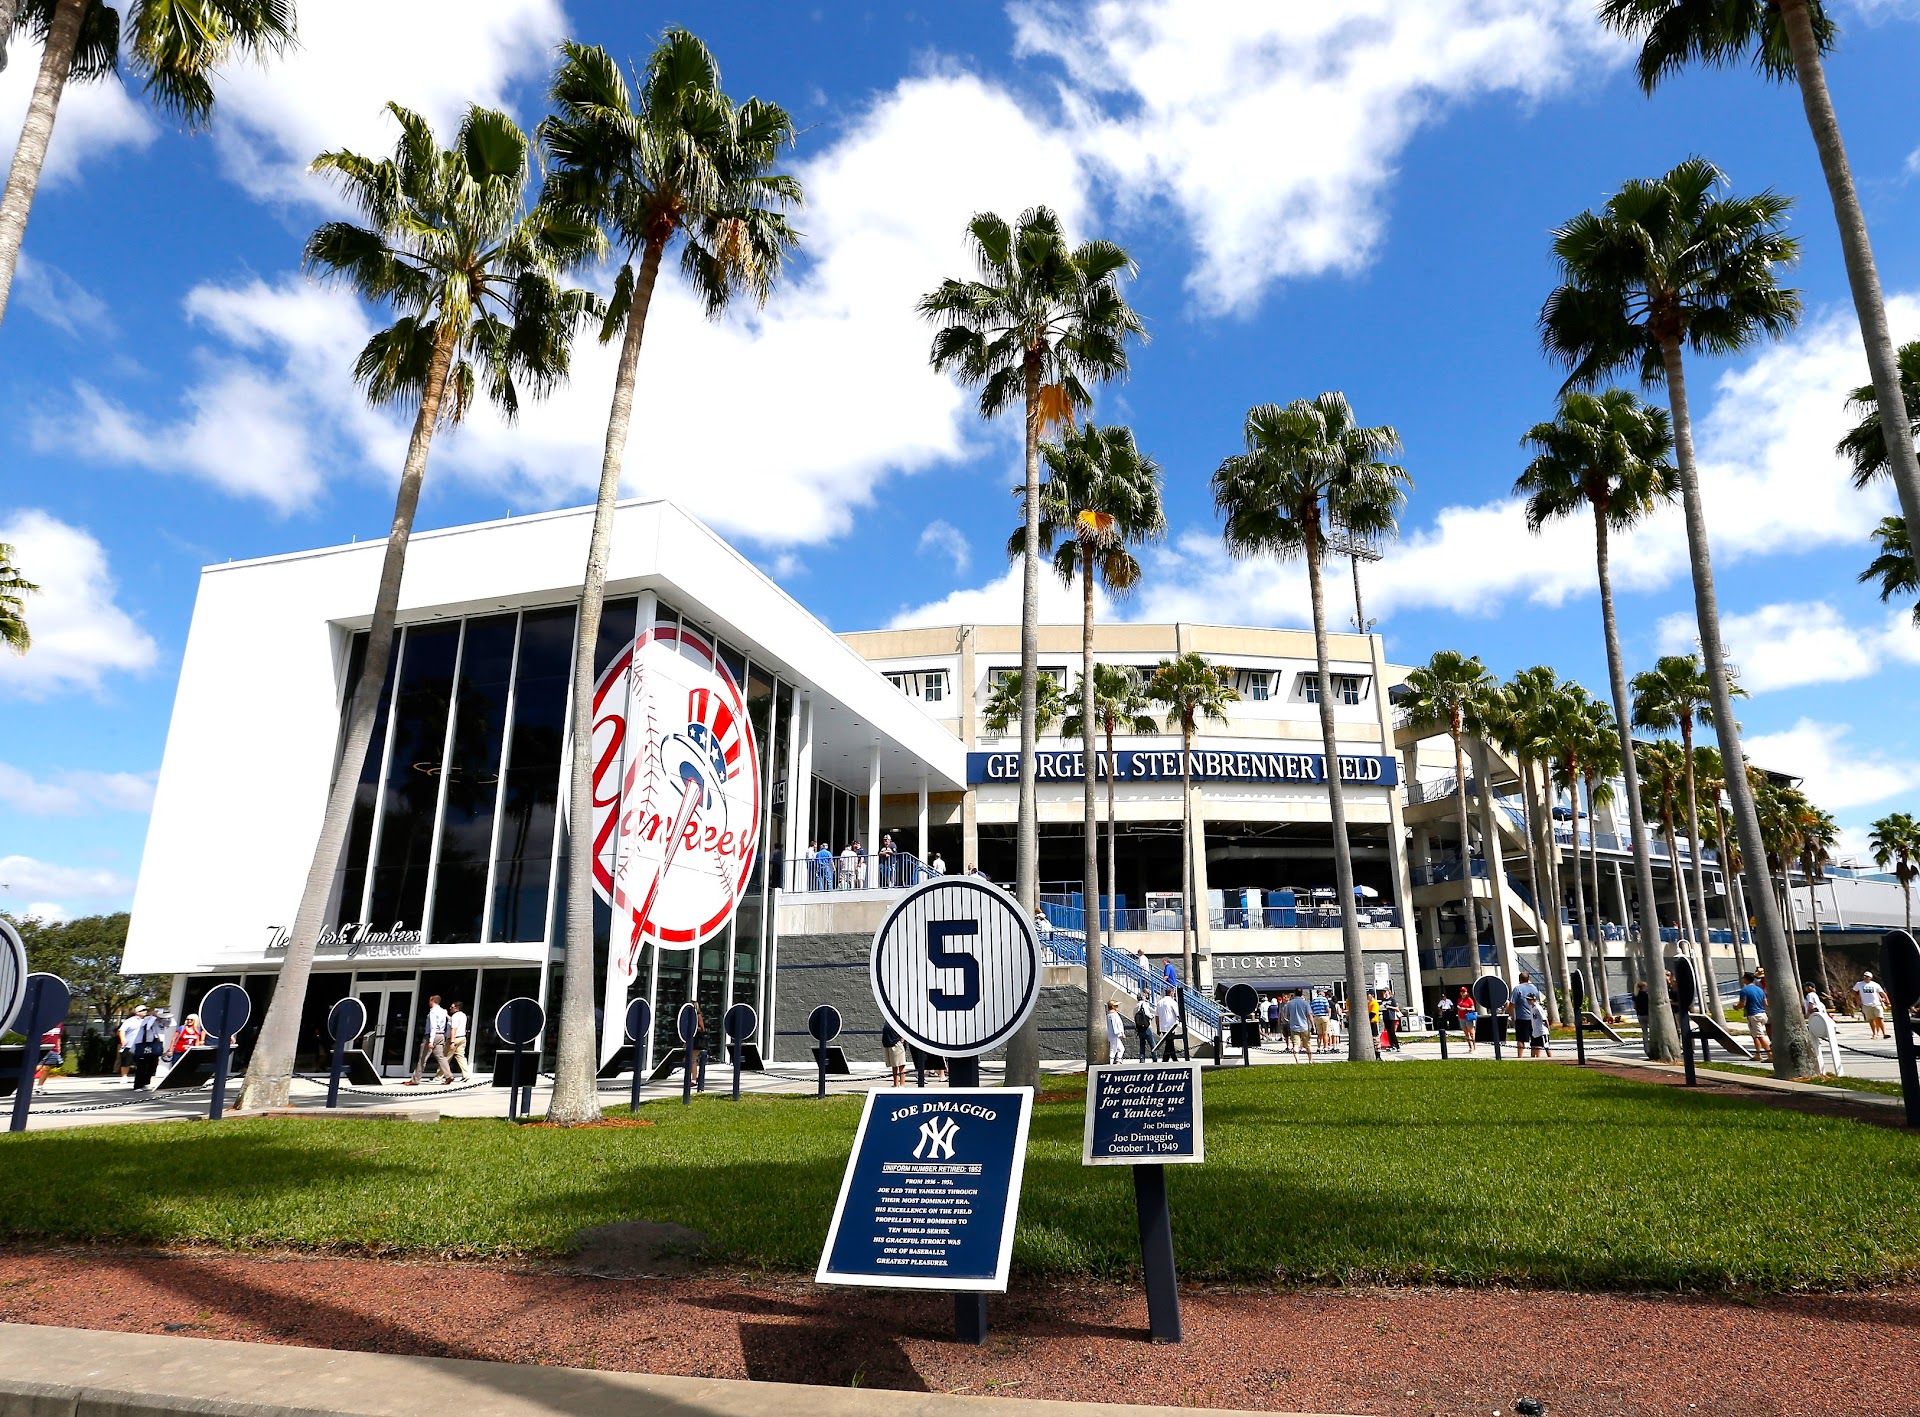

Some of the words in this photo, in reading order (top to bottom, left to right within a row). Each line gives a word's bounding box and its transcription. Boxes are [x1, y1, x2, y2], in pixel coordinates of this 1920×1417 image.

[987, 754, 1086, 778] GERGE
[1098, 753, 1126, 777] M.
[1132, 752, 1316, 779] STEINBRENNER
[349, 920, 422, 957] Yankees
[366, 945, 390, 957] TEAM
[392, 944, 422, 956] STORE
[927, 919, 981, 1011] 5
[1216, 956, 1302, 969] TICKETS
[1114, 1073, 1141, 1082] want
[1143, 1073, 1154, 1082] to
[1157, 1070, 1190, 1081] thank
[1103, 1085, 1121, 1095] the
[1124, 1083, 1154, 1094] Good
[1156, 1082, 1185, 1093] Lord
[1099, 1097, 1119, 1109] for
[1121, 1095, 1165, 1107] making
[1167, 1096, 1185, 1105] me
[891, 1104, 919, 1122] JOE
[1112, 1111, 1120, 1119] a
[1143, 1122, 1154, 1130] Joe
[1156, 1121, 1191, 1130] Dimaggio
[912, 1116, 960, 1160] NY
[1113, 1133, 1128, 1142] Joe
[1130, 1132, 1174, 1143] Dimaggio
[1108, 1144, 1144, 1153] October
[1146, 1143, 1154, 1153] 1,
[1157, 1142, 1179, 1152] 1949
[911, 1165, 938, 1173] NUMBER
[876, 1257, 910, 1265] GREATEST
